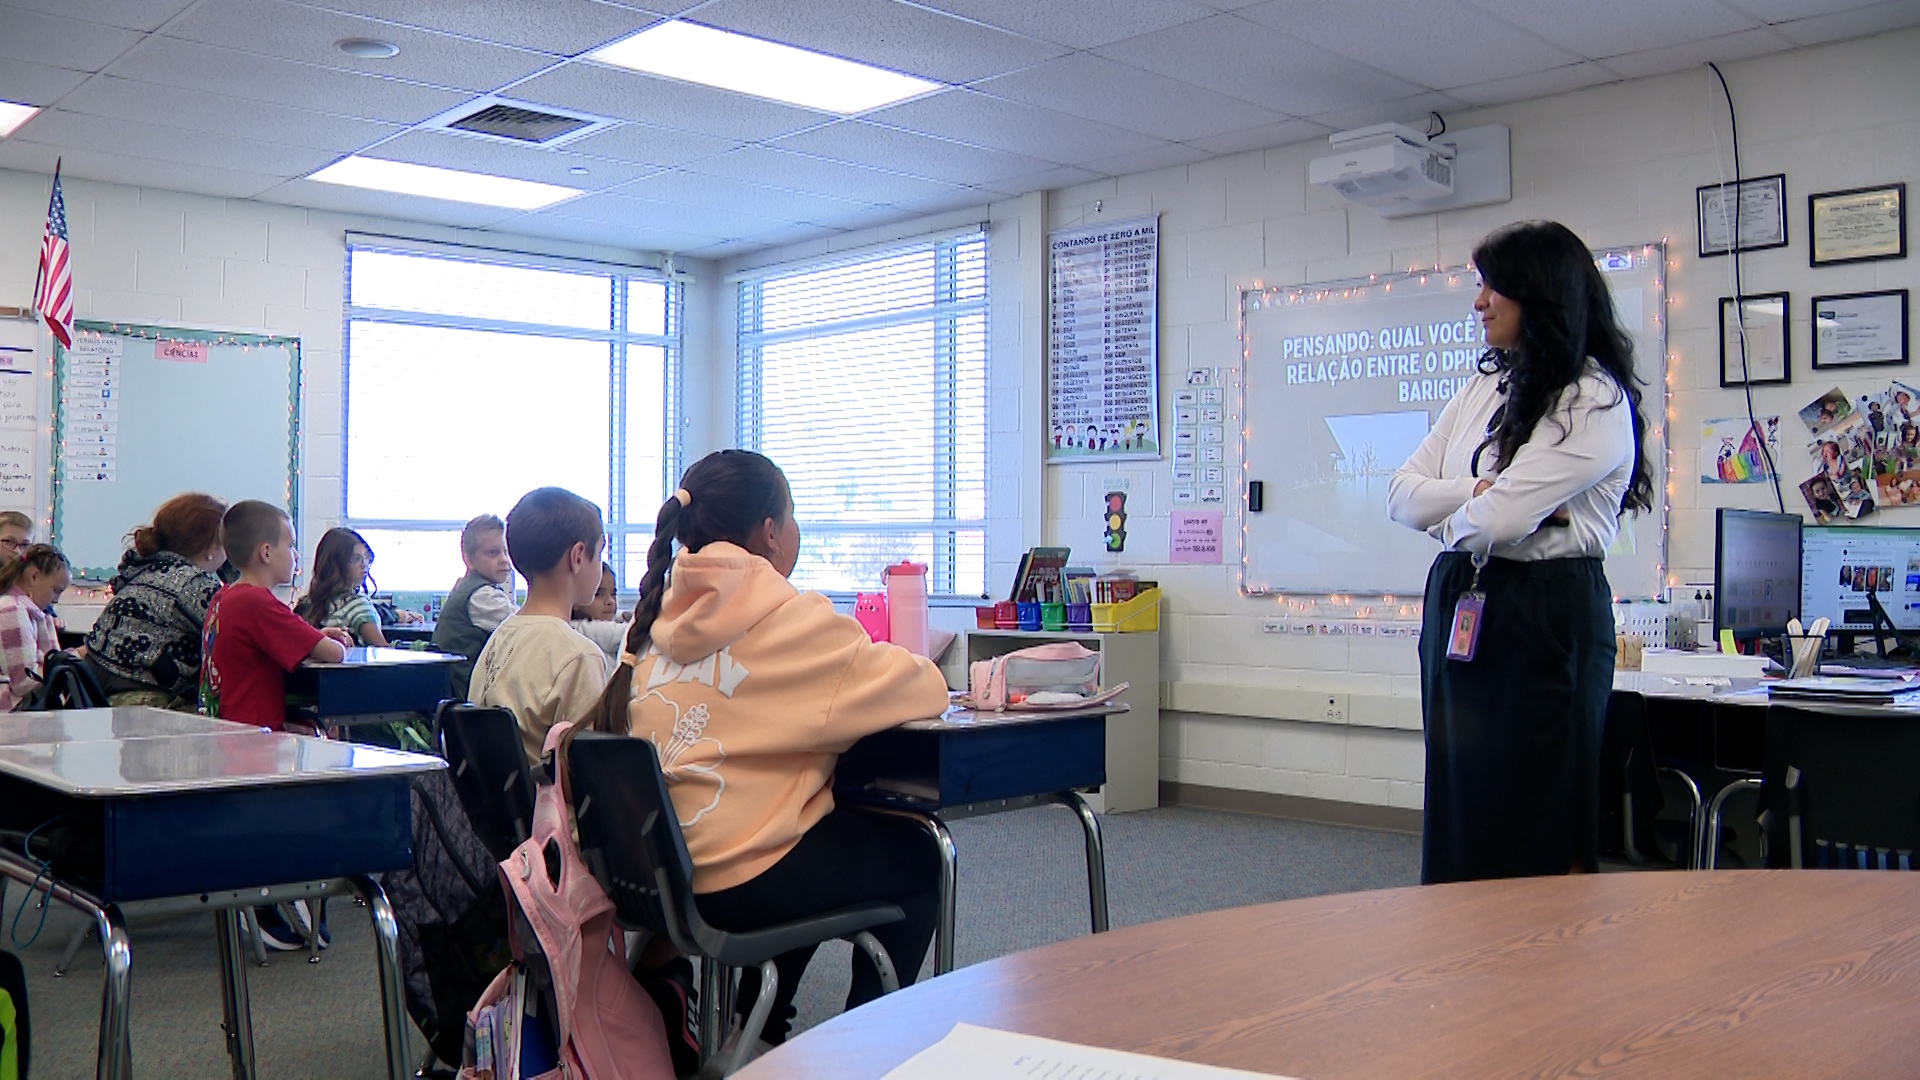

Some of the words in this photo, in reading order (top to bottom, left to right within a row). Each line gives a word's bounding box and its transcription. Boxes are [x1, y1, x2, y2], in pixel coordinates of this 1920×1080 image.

[1052, 236, 1095, 250] CONTANDO
[1097, 233, 1108, 242] DE
[1110, 229, 1132, 240] ZERO
[1142, 226, 1155, 234] MIL
[1283, 329, 1375, 359] PENSANDO:
[1379, 325, 1424, 350] QUAL
[1428, 313, 1476, 346] VOCÊ
[1287, 354, 1363, 387] RELAÇÃO
[1366, 351, 1421, 378] ENTRE
[1425, 350, 1438, 373] O
[1399, 377, 1471, 402] BARIGU
